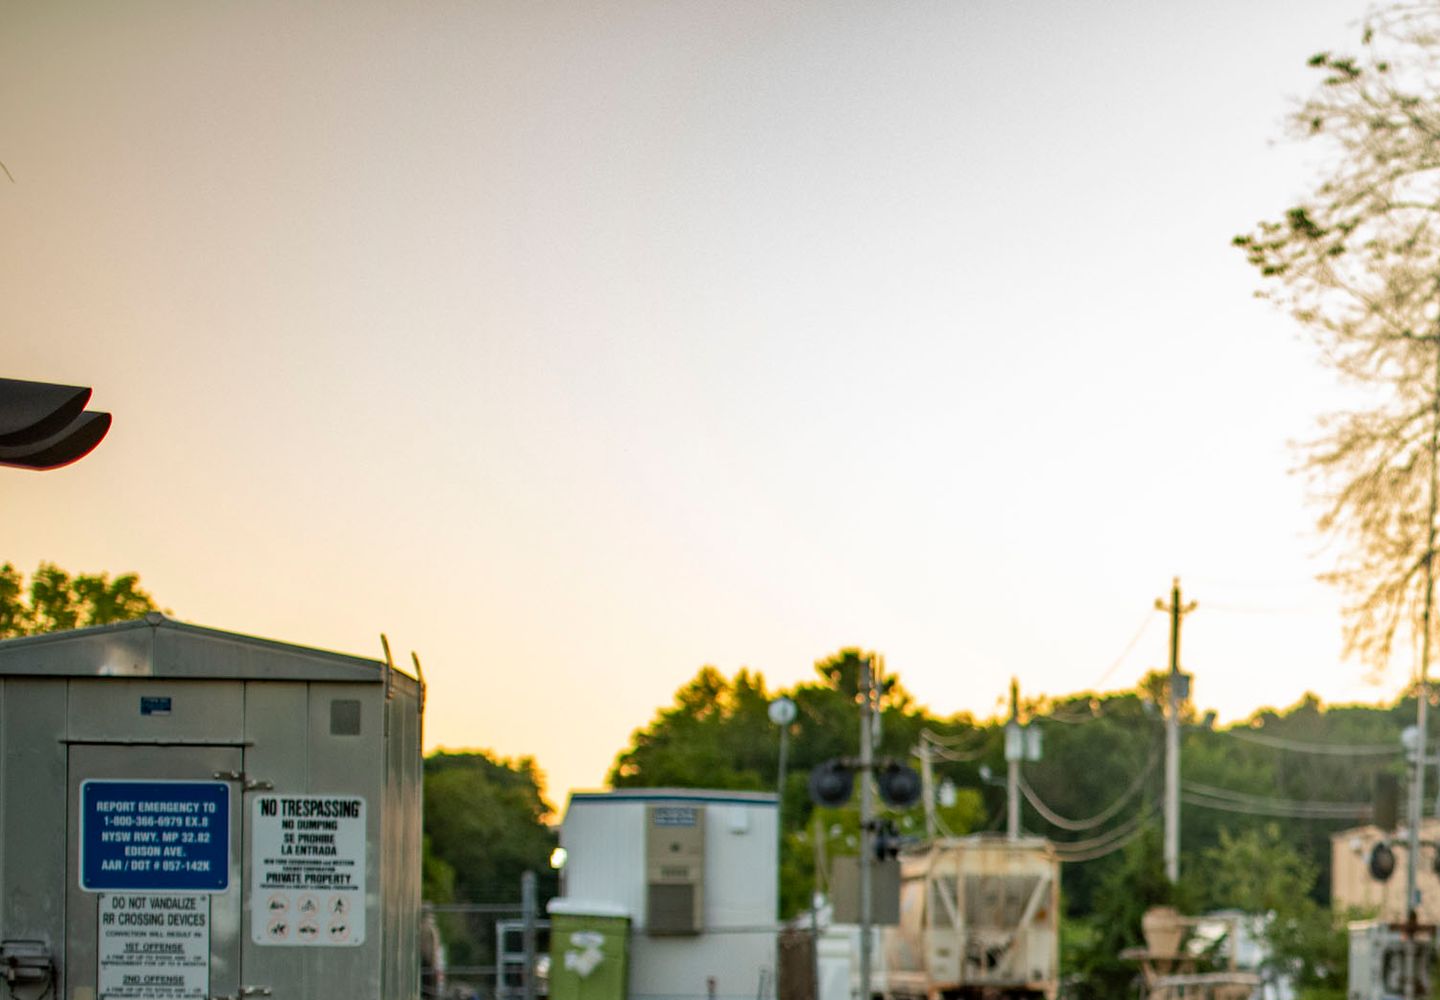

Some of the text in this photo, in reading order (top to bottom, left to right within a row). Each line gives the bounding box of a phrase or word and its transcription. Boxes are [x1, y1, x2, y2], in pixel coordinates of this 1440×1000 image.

[96, 801, 216, 813] REPORT EMERGENCY TO
[261, 799, 359, 818] NO TRESPASSING
[282, 820, 338, 831] NO DUMPING
[101, 832, 131, 842] NYSW
[133, 832, 159, 842] RWY.
[162, 832, 179, 842] MP
[284, 833, 335, 844] SE PROHIBE
[124, 846, 187, 857] EDISON AVE.
[281, 845, 337, 855] LA ENTRADA
[101, 860, 121, 870] AAR
[131, 860, 150, 871] DOT
[153, 860, 160, 870] #
[266, 872, 351, 884] PRIVATE PROPERTY
[112, 896, 196, 910] DO NOT VANDALIZE
[103, 912, 206, 926] RR CROSSING DEVICES
[125, 943, 184, 952] 1ST OFFENSE
[143, 975, 185, 984] OFFENSE
